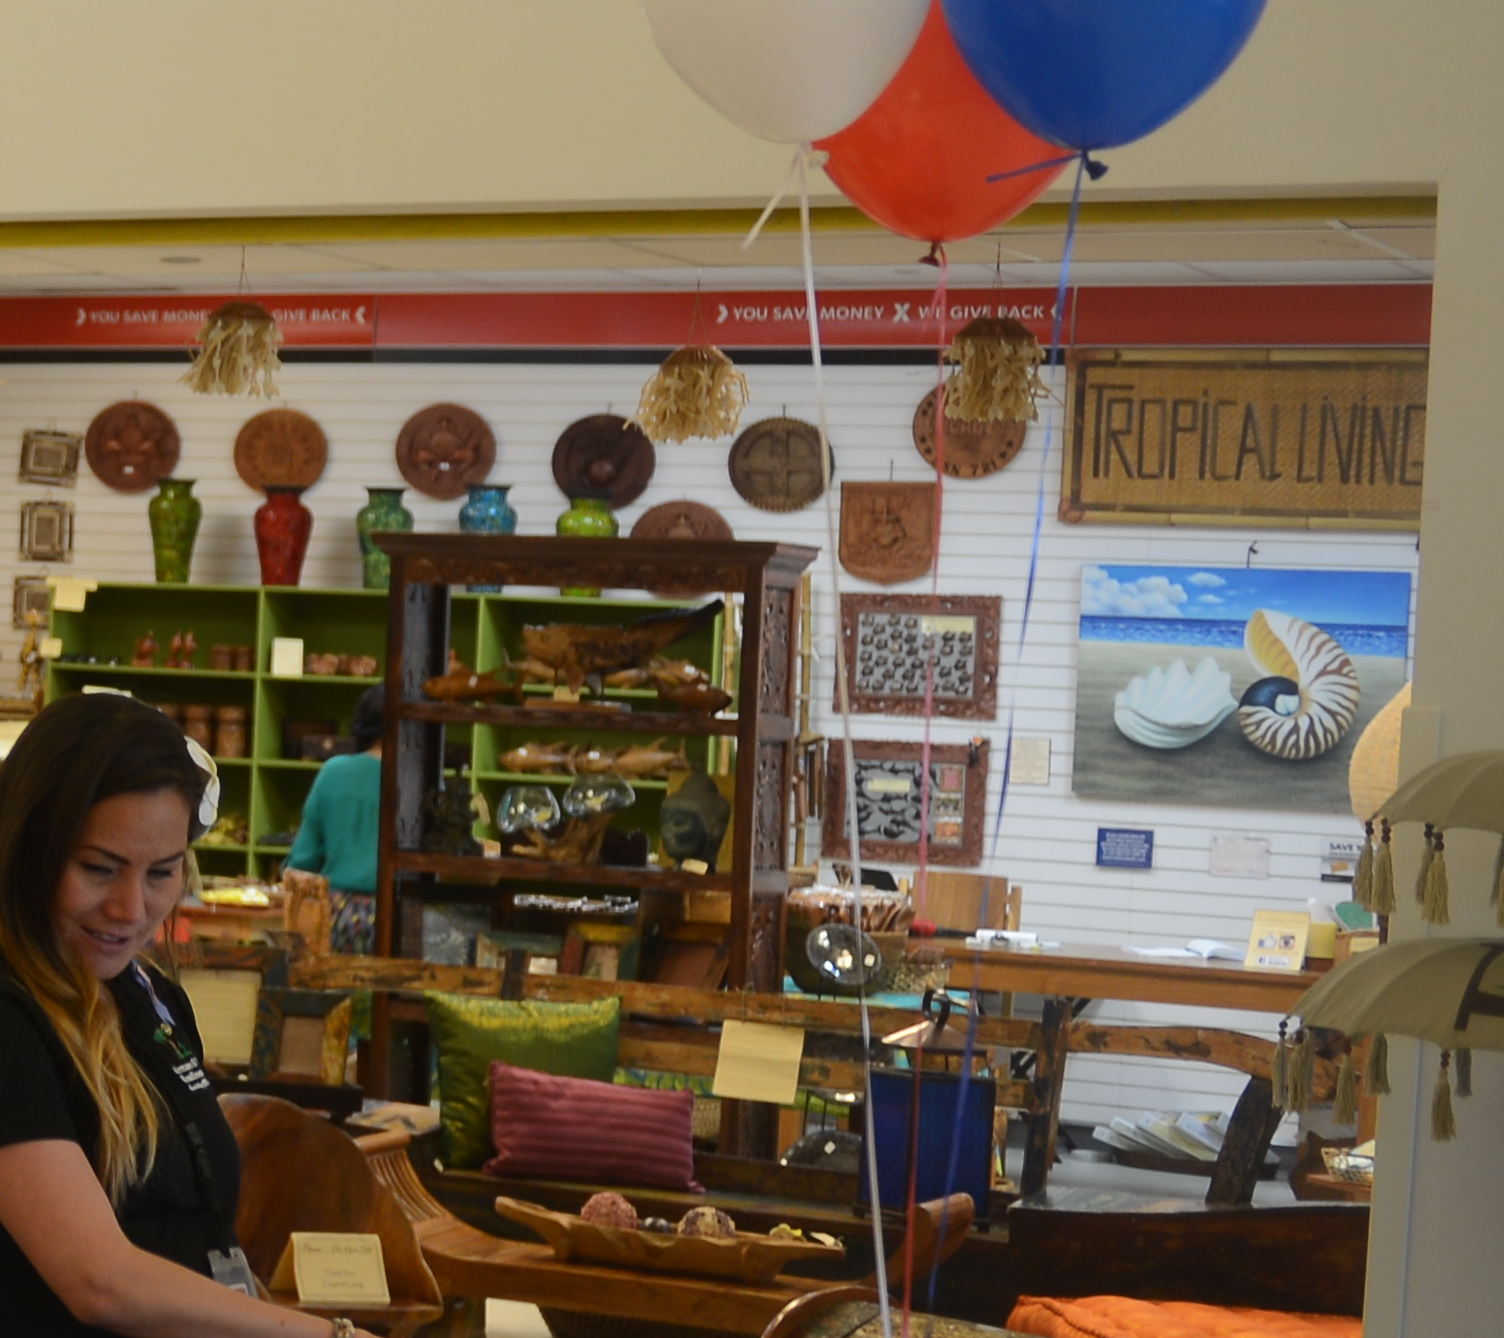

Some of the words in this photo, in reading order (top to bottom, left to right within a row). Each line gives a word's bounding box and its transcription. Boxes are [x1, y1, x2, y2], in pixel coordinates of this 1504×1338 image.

[90, 310, 119, 323] YOU
[124, 310, 158, 323] SAVE
[164, 309, 211, 322] MONE
[272, 308, 307, 322] GIVE
[313, 308, 350, 322] BACK
[734, 307, 769, 321] YOU
[773, 306, 810, 321] SAV
[821, 305, 884, 321] MONEY
[951, 306, 990, 320] GIVE
[997, 305, 1044, 319] BACK
[1089, 383, 1282, 482] TROPICAL
[1296, 393, 1427, 488] LIVING
